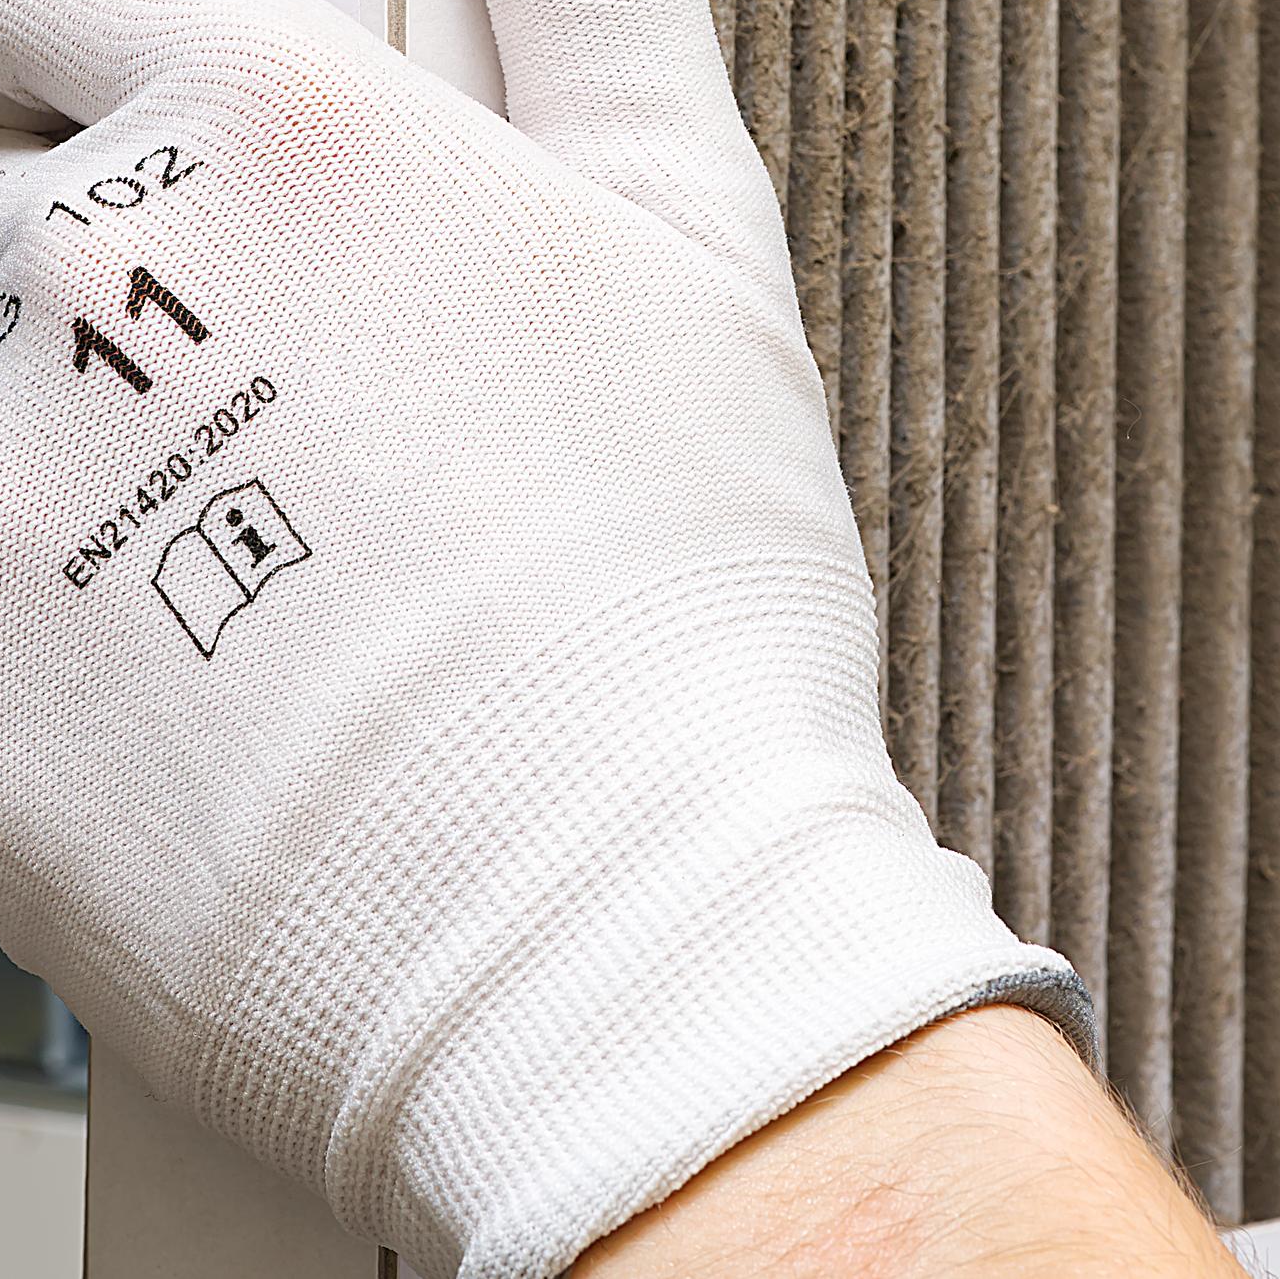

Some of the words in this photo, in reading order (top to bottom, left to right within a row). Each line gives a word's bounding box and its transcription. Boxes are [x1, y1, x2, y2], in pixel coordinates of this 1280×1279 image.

[46, 145, 205, 225] 102
[71, 266, 212, 394] 11
[62, 376, 278, 589] EN21420:2020
